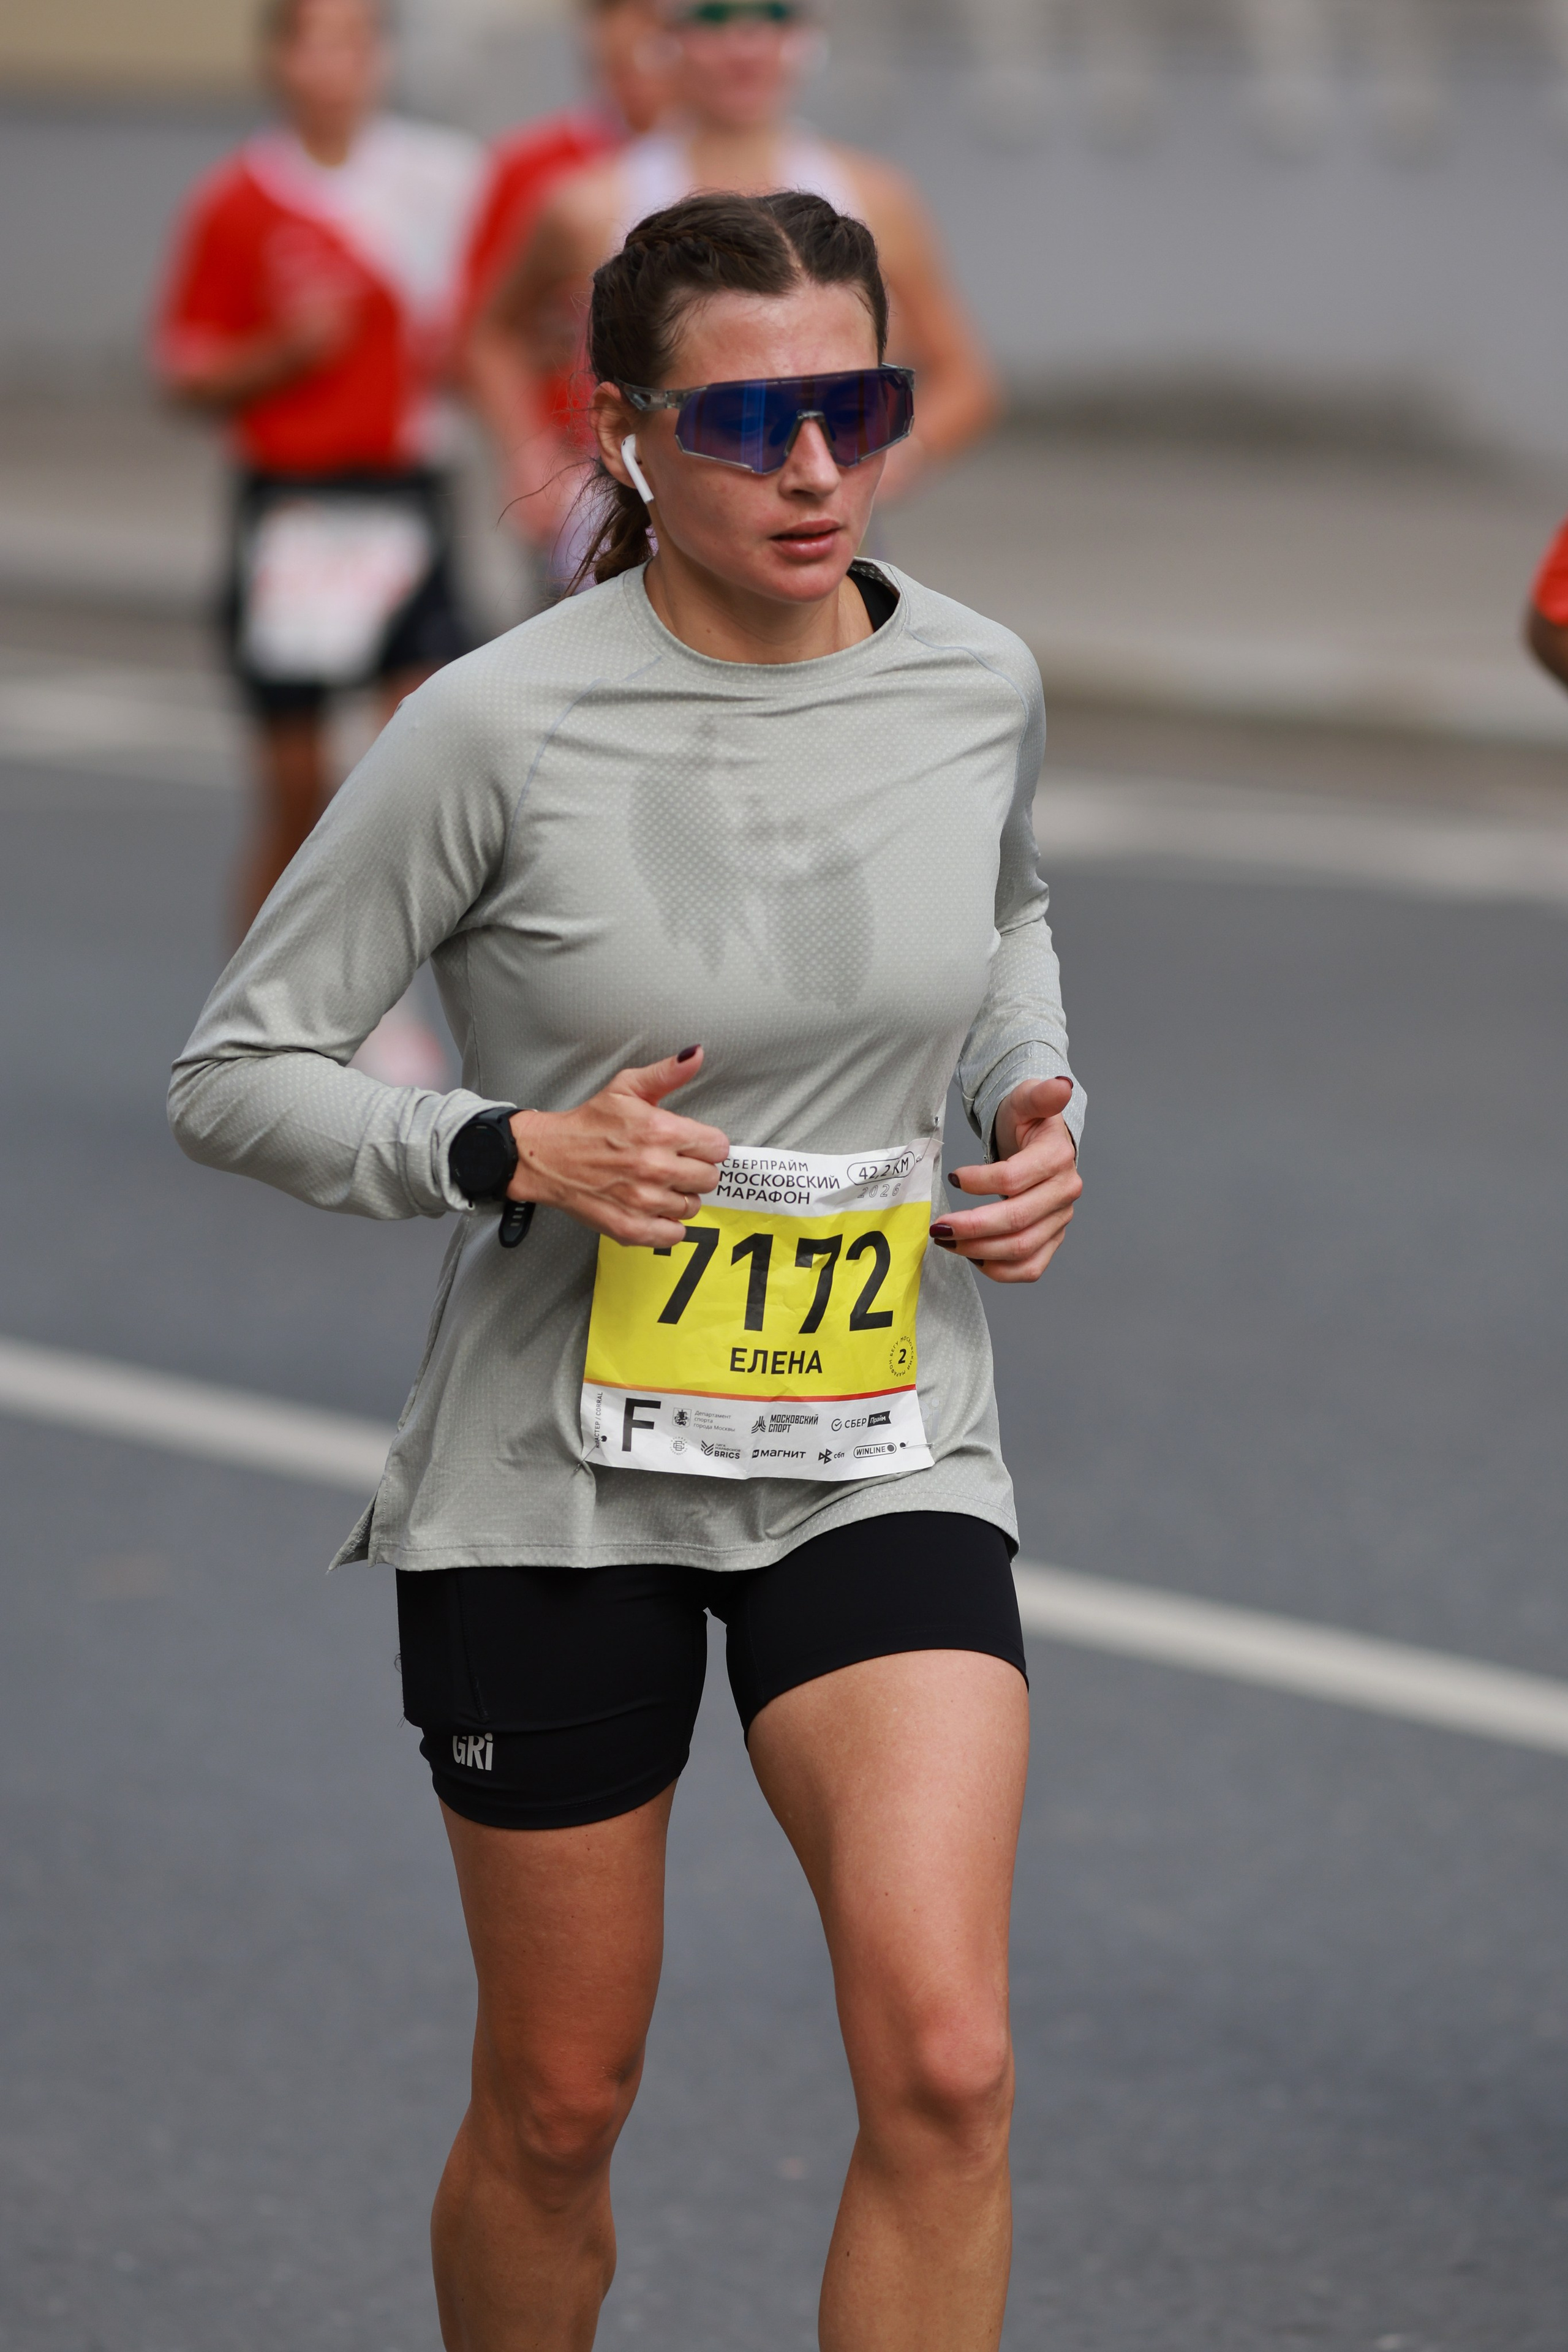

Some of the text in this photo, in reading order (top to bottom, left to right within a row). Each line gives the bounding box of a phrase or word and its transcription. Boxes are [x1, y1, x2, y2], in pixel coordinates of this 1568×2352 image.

[722, 1158, 809, 1172] СБЕРПРАЙМ
[859, 1164, 891, 1180] 42,2
[719, 1170, 840, 1189] МОСКОВСКИЙ
[717, 1185, 810, 1205] МАРАФОН
[858, 1183, 901, 1199] 2026
[653, 1226, 894, 1334] 7172
[729, 1347, 823, 1374] ЕЛЕНА
[897, 1348, 907, 1364] 2
[695, 1411, 732, 1419] Департамент
[769, 1414, 819, 1425] МОСКОВСКИЙ
[844, 1414, 886, 1428] СБЕР Прайм
[622, 1397, 662, 1452] F
[768, 1423, 792, 1433] СПОРТ
[714, 1450, 741, 1459] BRICS
[760, 1449, 807, 1458] магнит
[856, 1446, 886, 1456] WINLINE
